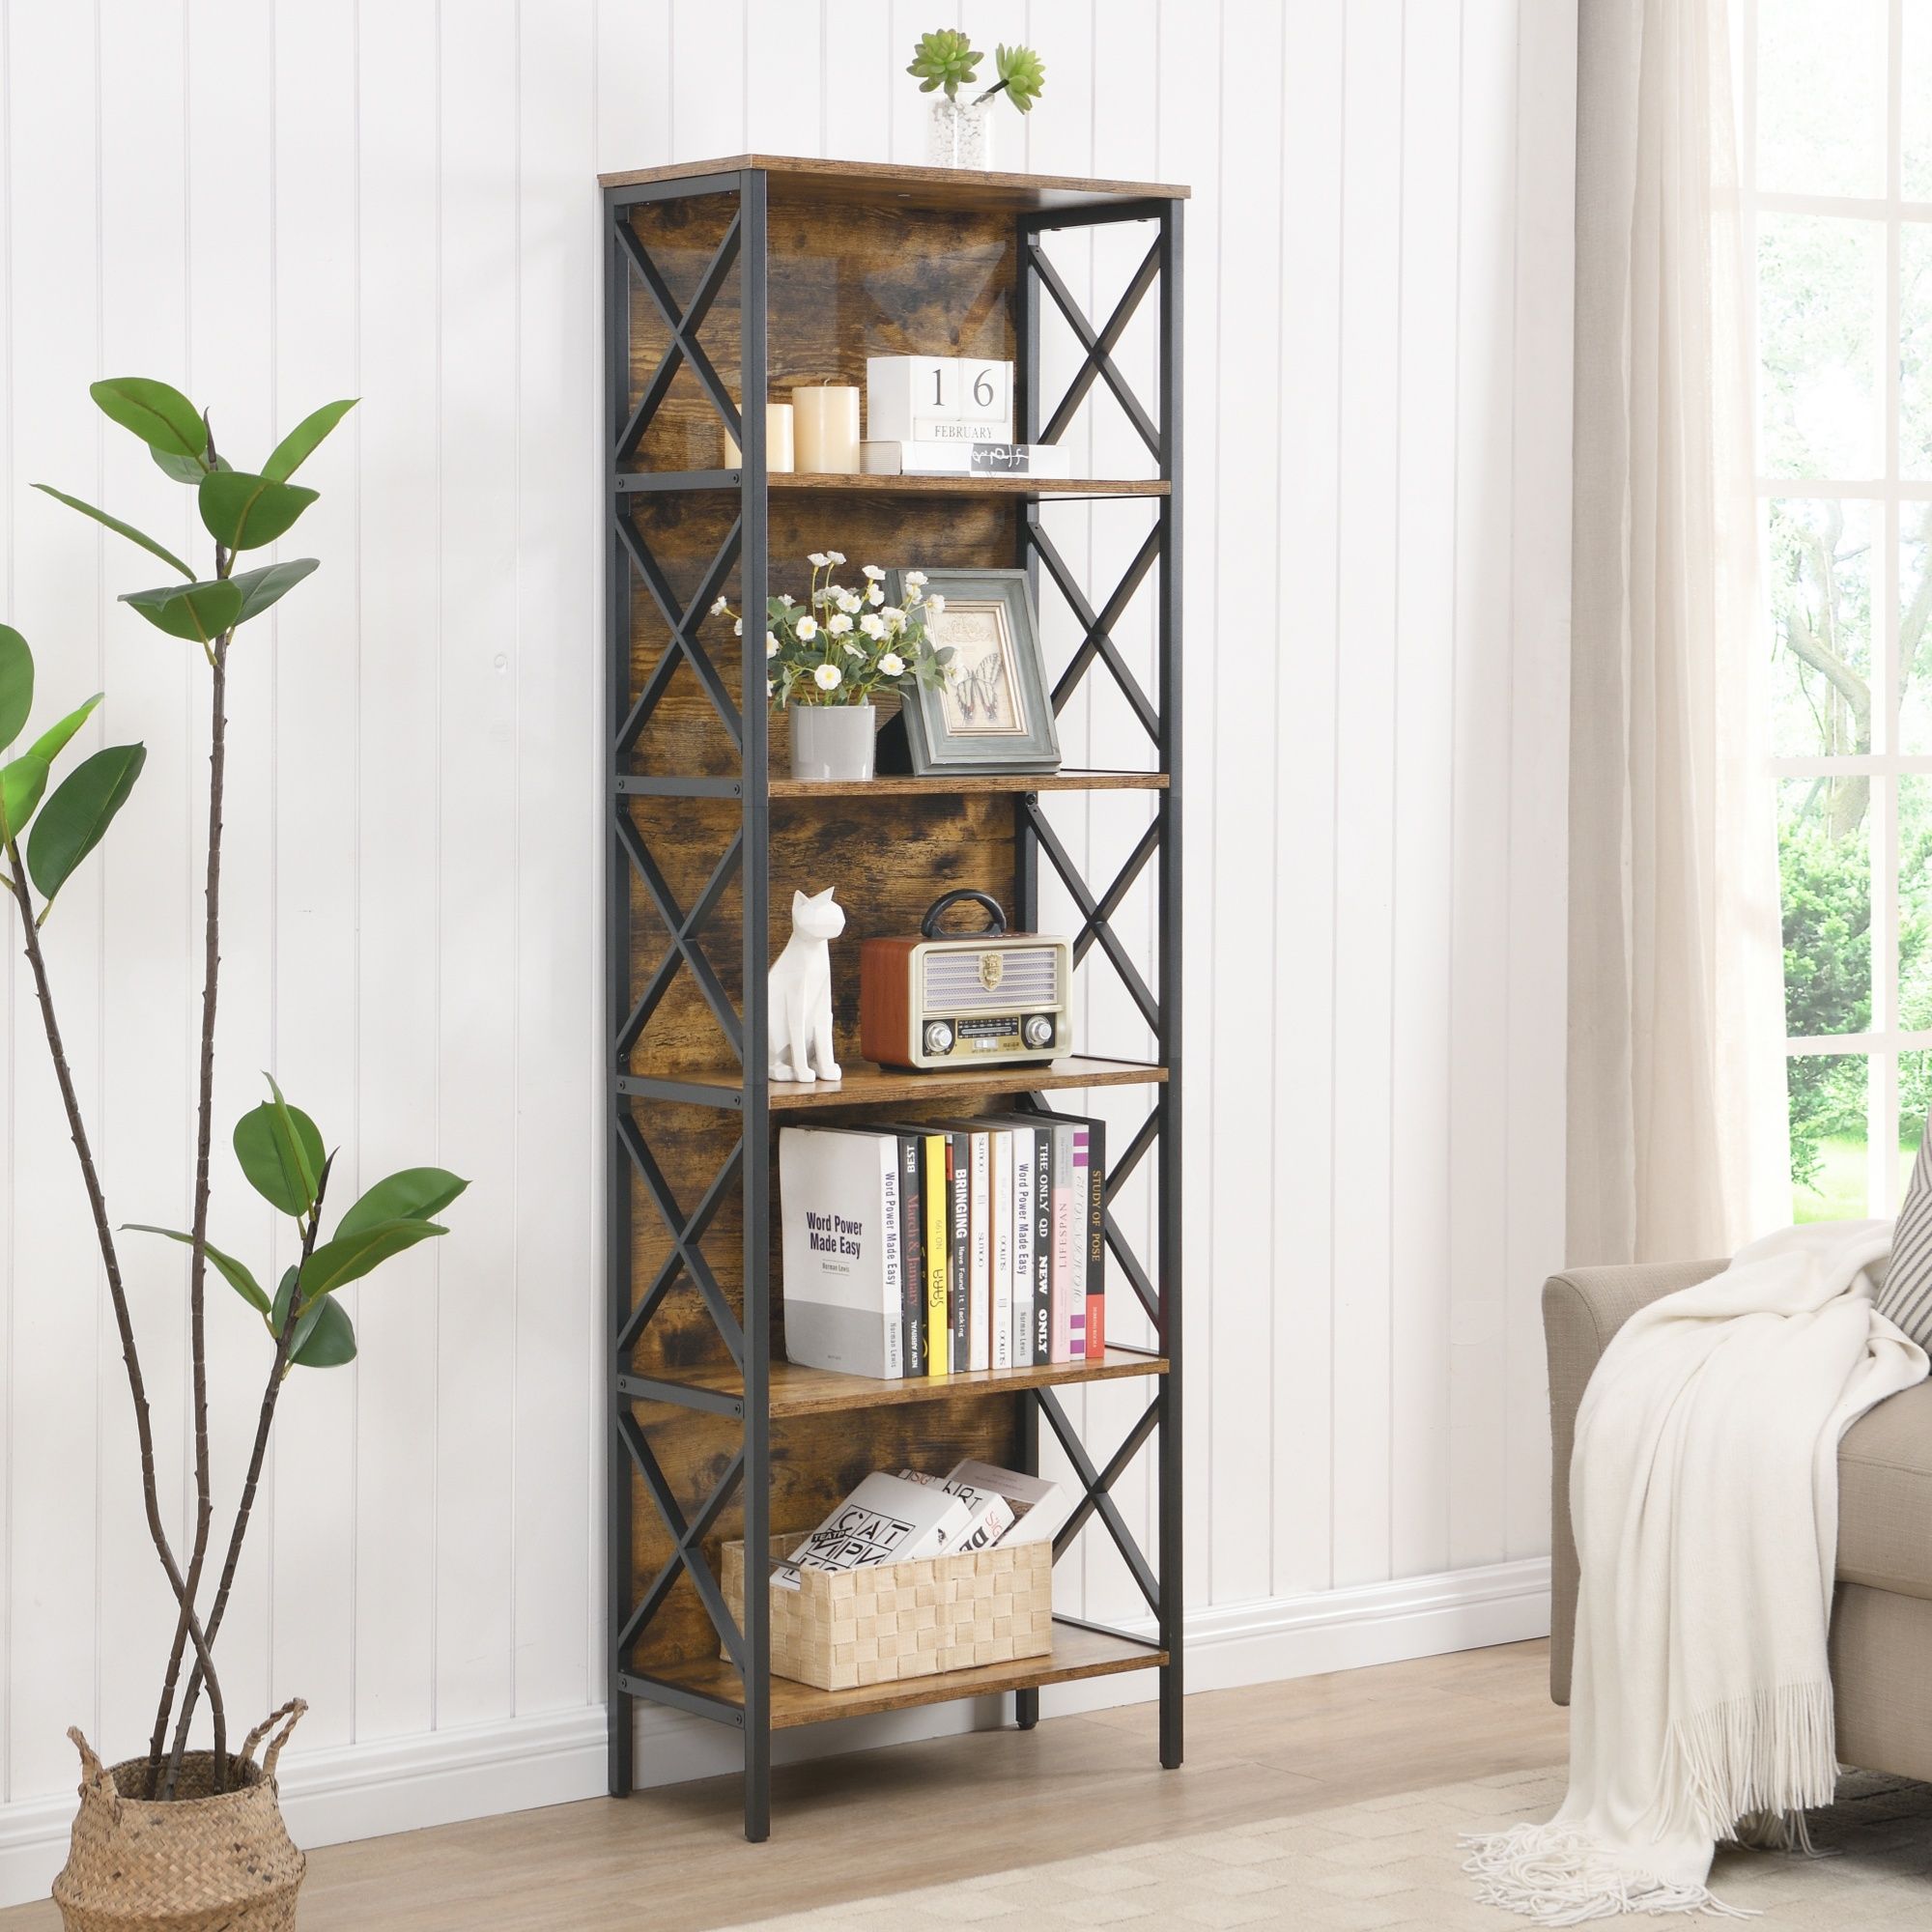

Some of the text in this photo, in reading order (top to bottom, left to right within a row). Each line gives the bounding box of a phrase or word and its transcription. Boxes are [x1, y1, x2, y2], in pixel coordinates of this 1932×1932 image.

[934, 425, 994, 440] FEBRUARY
[906, 1145, 916, 1173] BEST
[954, 1168, 968, 1238] BRINGING
[1038, 1143, 1050, 1237] THE ONLY QD
[806, 1211, 863, 1236] Word Power
[885, 1171, 897, 1286] Word Power Made Easy
[907, 1194, 920, 1235] March
[1016, 1163, 1029, 1275] Word Power Made Easy
[1059, 1203, 1067, 1267] LIFESPAN
[1092, 1170, 1101, 1262] STUDY OF POSE
[810, 1233, 861, 1260] Made Easy
[907, 1255, 921, 1307] January
[1037, 1255, 1048, 1294] NEW
[910, 1320, 919, 1350] ARRIVAL
[1037, 1308, 1048, 1354] ONLY
